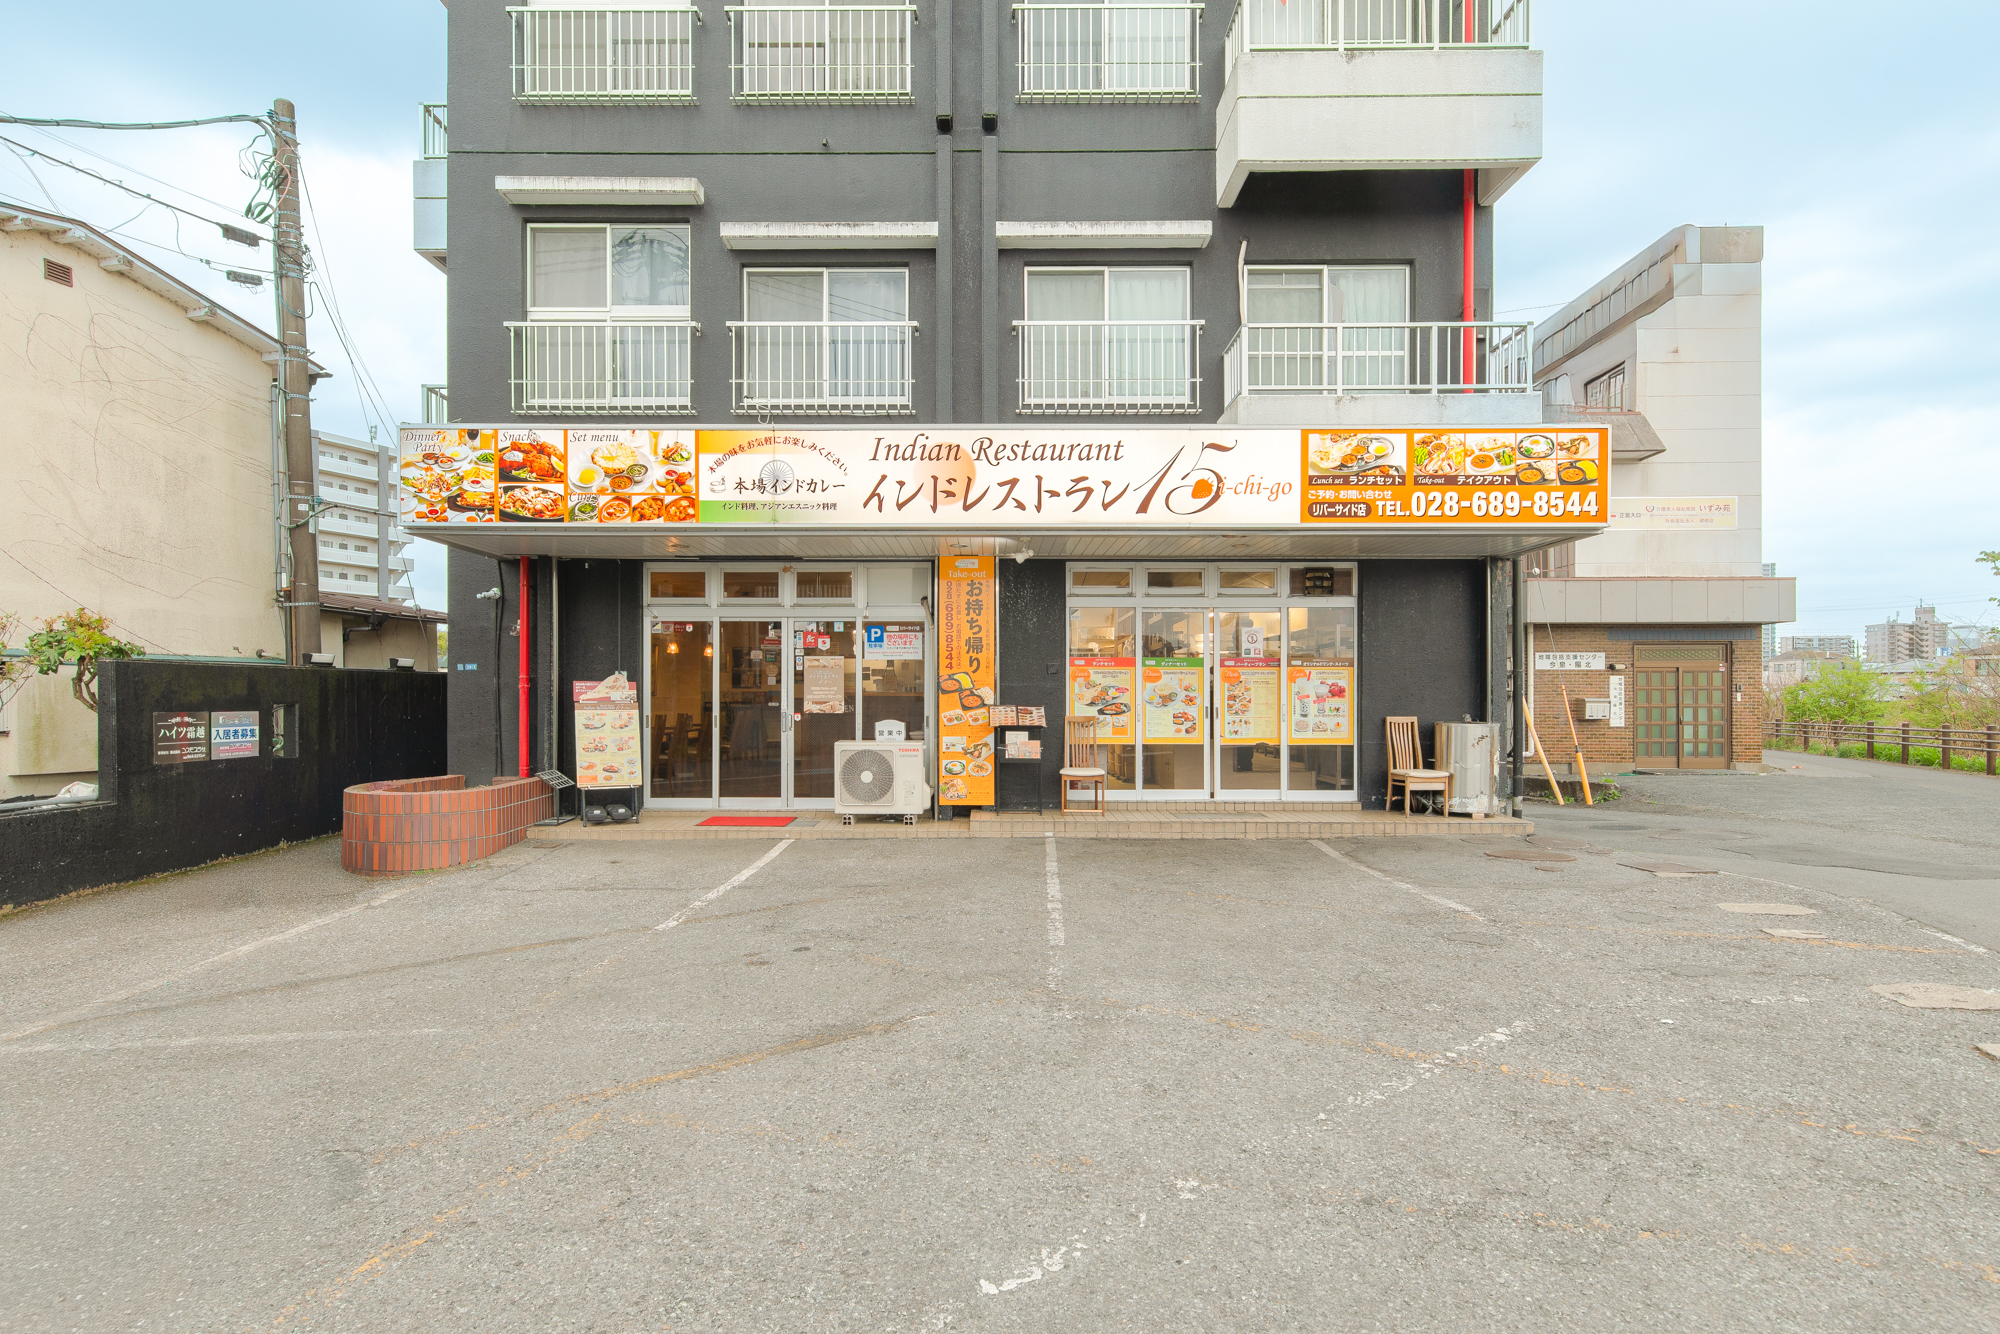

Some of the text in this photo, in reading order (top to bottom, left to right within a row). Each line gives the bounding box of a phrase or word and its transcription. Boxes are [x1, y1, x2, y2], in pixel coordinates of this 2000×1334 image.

[403, 431, 442, 442] Dinner
[570, 432, 619, 442] Set menu
[413, 442, 444, 454] Party
[869, 433, 1124, 466] Indian Restaurant
[707, 435, 848, 476] 本場の味をお気軽にお楽しみください。
[1133, 439, 1292, 515] 15 i-chi-go
[1312, 475, 1403, 485] Lunch set ランチセット
[1417, 475, 1511, 485] Take-out テイクアウト
[733, 476, 846, 495] 本場インドカレー
[570, 491, 600, 504] Curry
[863, 474, 1130, 514] インドレストラン
[1307, 490, 1392, 499] ご予約・お問い合わせ
[722, 502, 838, 511] インド料理、アジアンエスニック料理
[1312, 503, 1367, 517] リバーサイド店
[947, 569, 986, 578] Take-out
[965, 579, 984, 674] お持ち帰り
[871, 628, 881, 642] P
[213, 728, 258, 741] 入居者募集
